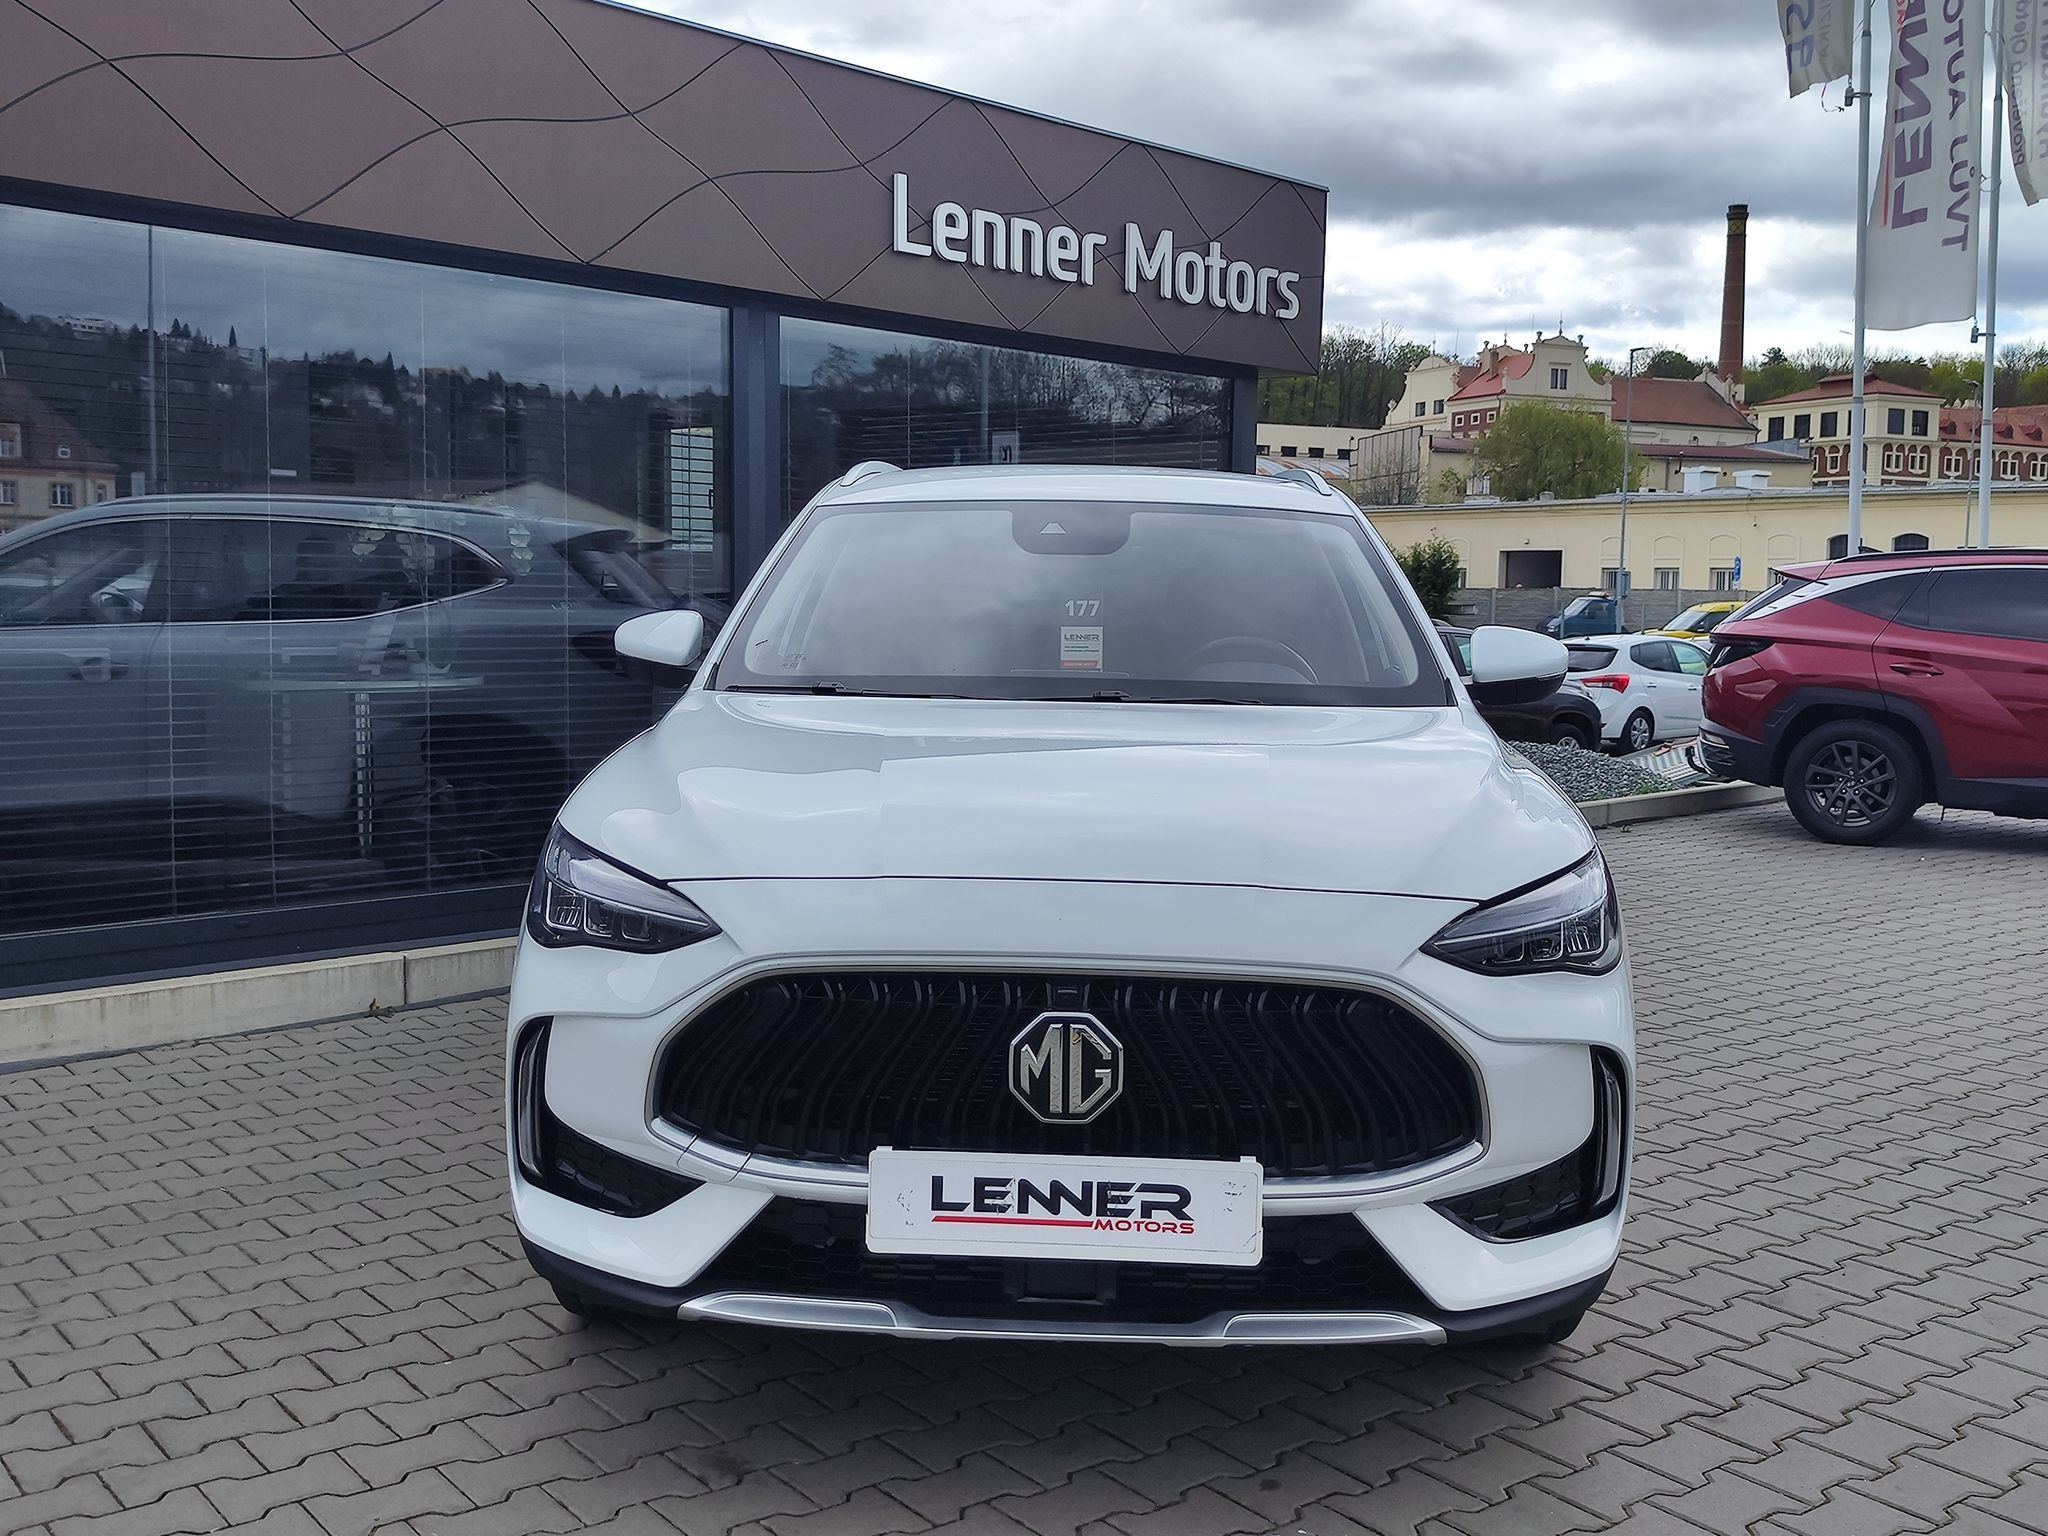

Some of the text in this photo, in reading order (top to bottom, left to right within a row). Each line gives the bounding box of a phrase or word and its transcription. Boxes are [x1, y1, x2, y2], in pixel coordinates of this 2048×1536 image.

[893, 173, 1300, 319] Lenner Motors
[1064, 600, 1100, 616] 177
[1020, 1023, 1112, 1114] MG
[931, 1175, 1195, 1221] LENNER
[1093, 1218, 1195, 1235] MOTORS
